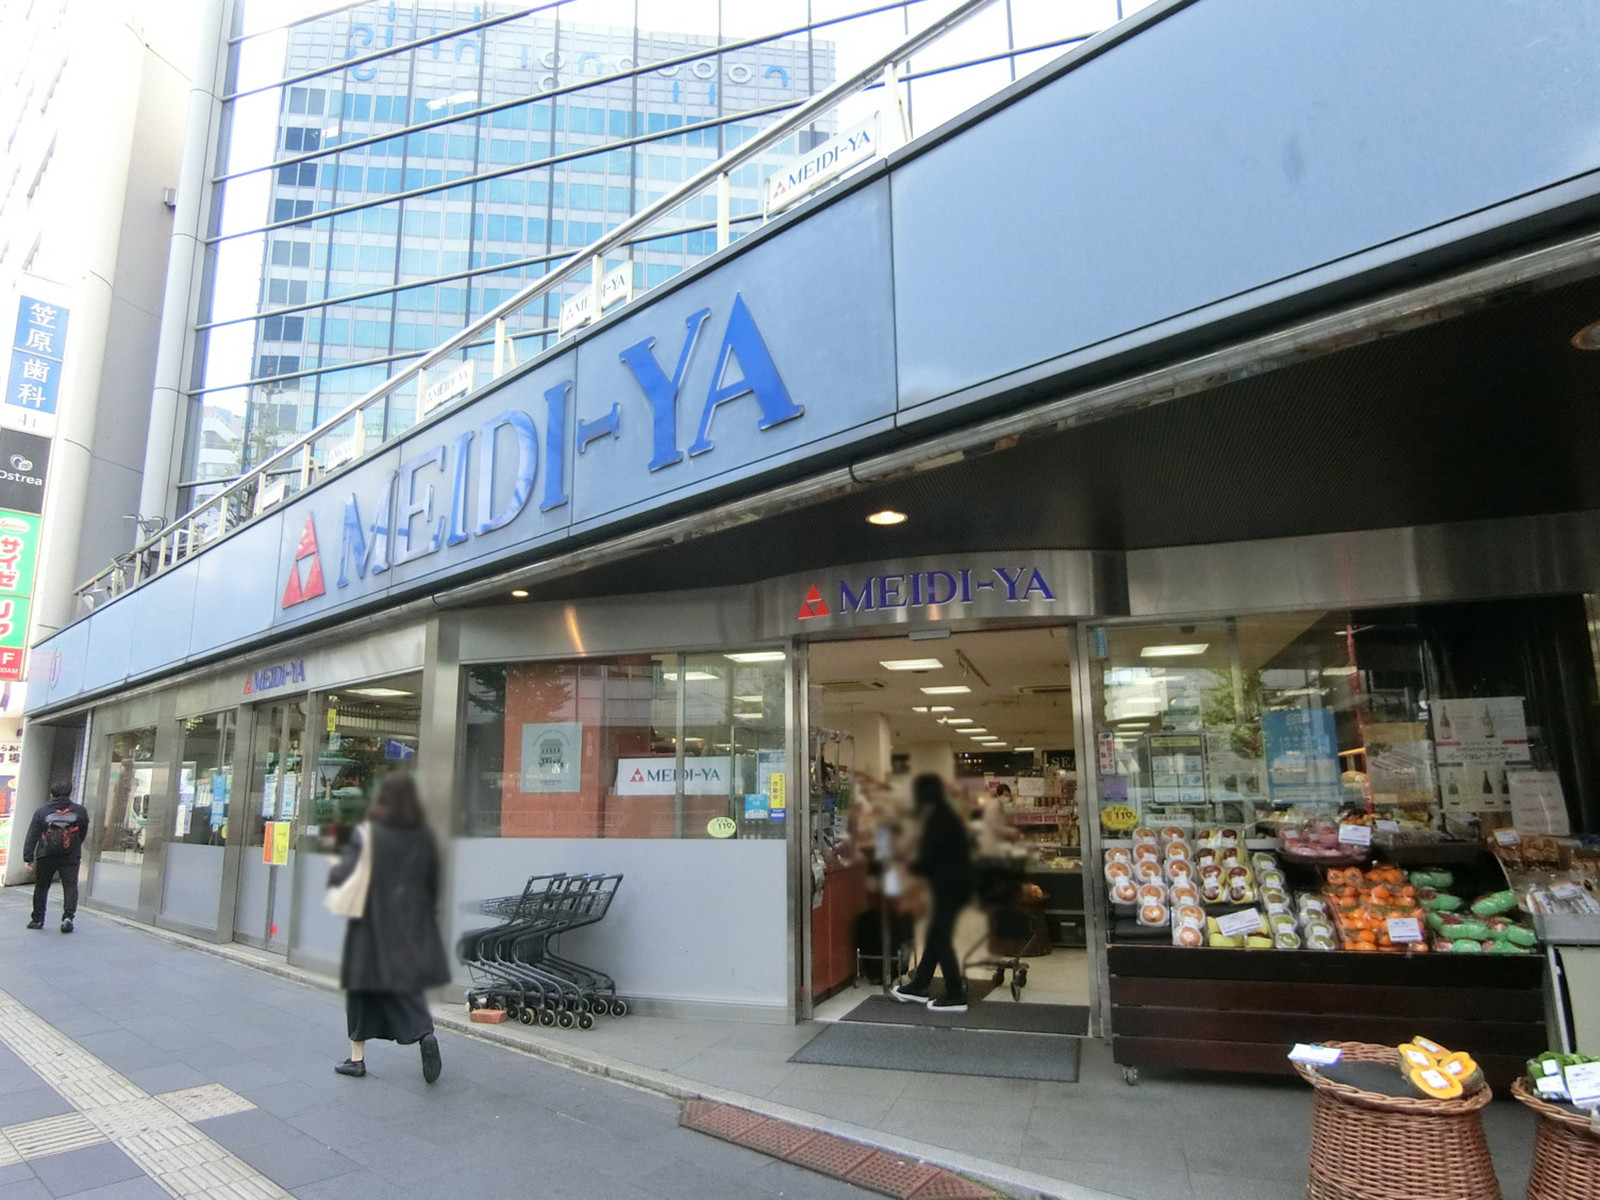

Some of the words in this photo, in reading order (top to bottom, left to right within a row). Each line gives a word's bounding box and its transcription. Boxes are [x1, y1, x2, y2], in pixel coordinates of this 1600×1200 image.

[788, 130, 871, 190] MEIDI-YA
[575, 274, 625, 312] MEI-YA
[17, 302, 58, 409] 笠原歯科
[337, 290, 805, 589] MEIDI-YA
[0, 469, 43, 486] Ostrea
[839, 566, 1056, 615] MEIDI-YA
[254, 659, 306, 692] MEIDI-YA
